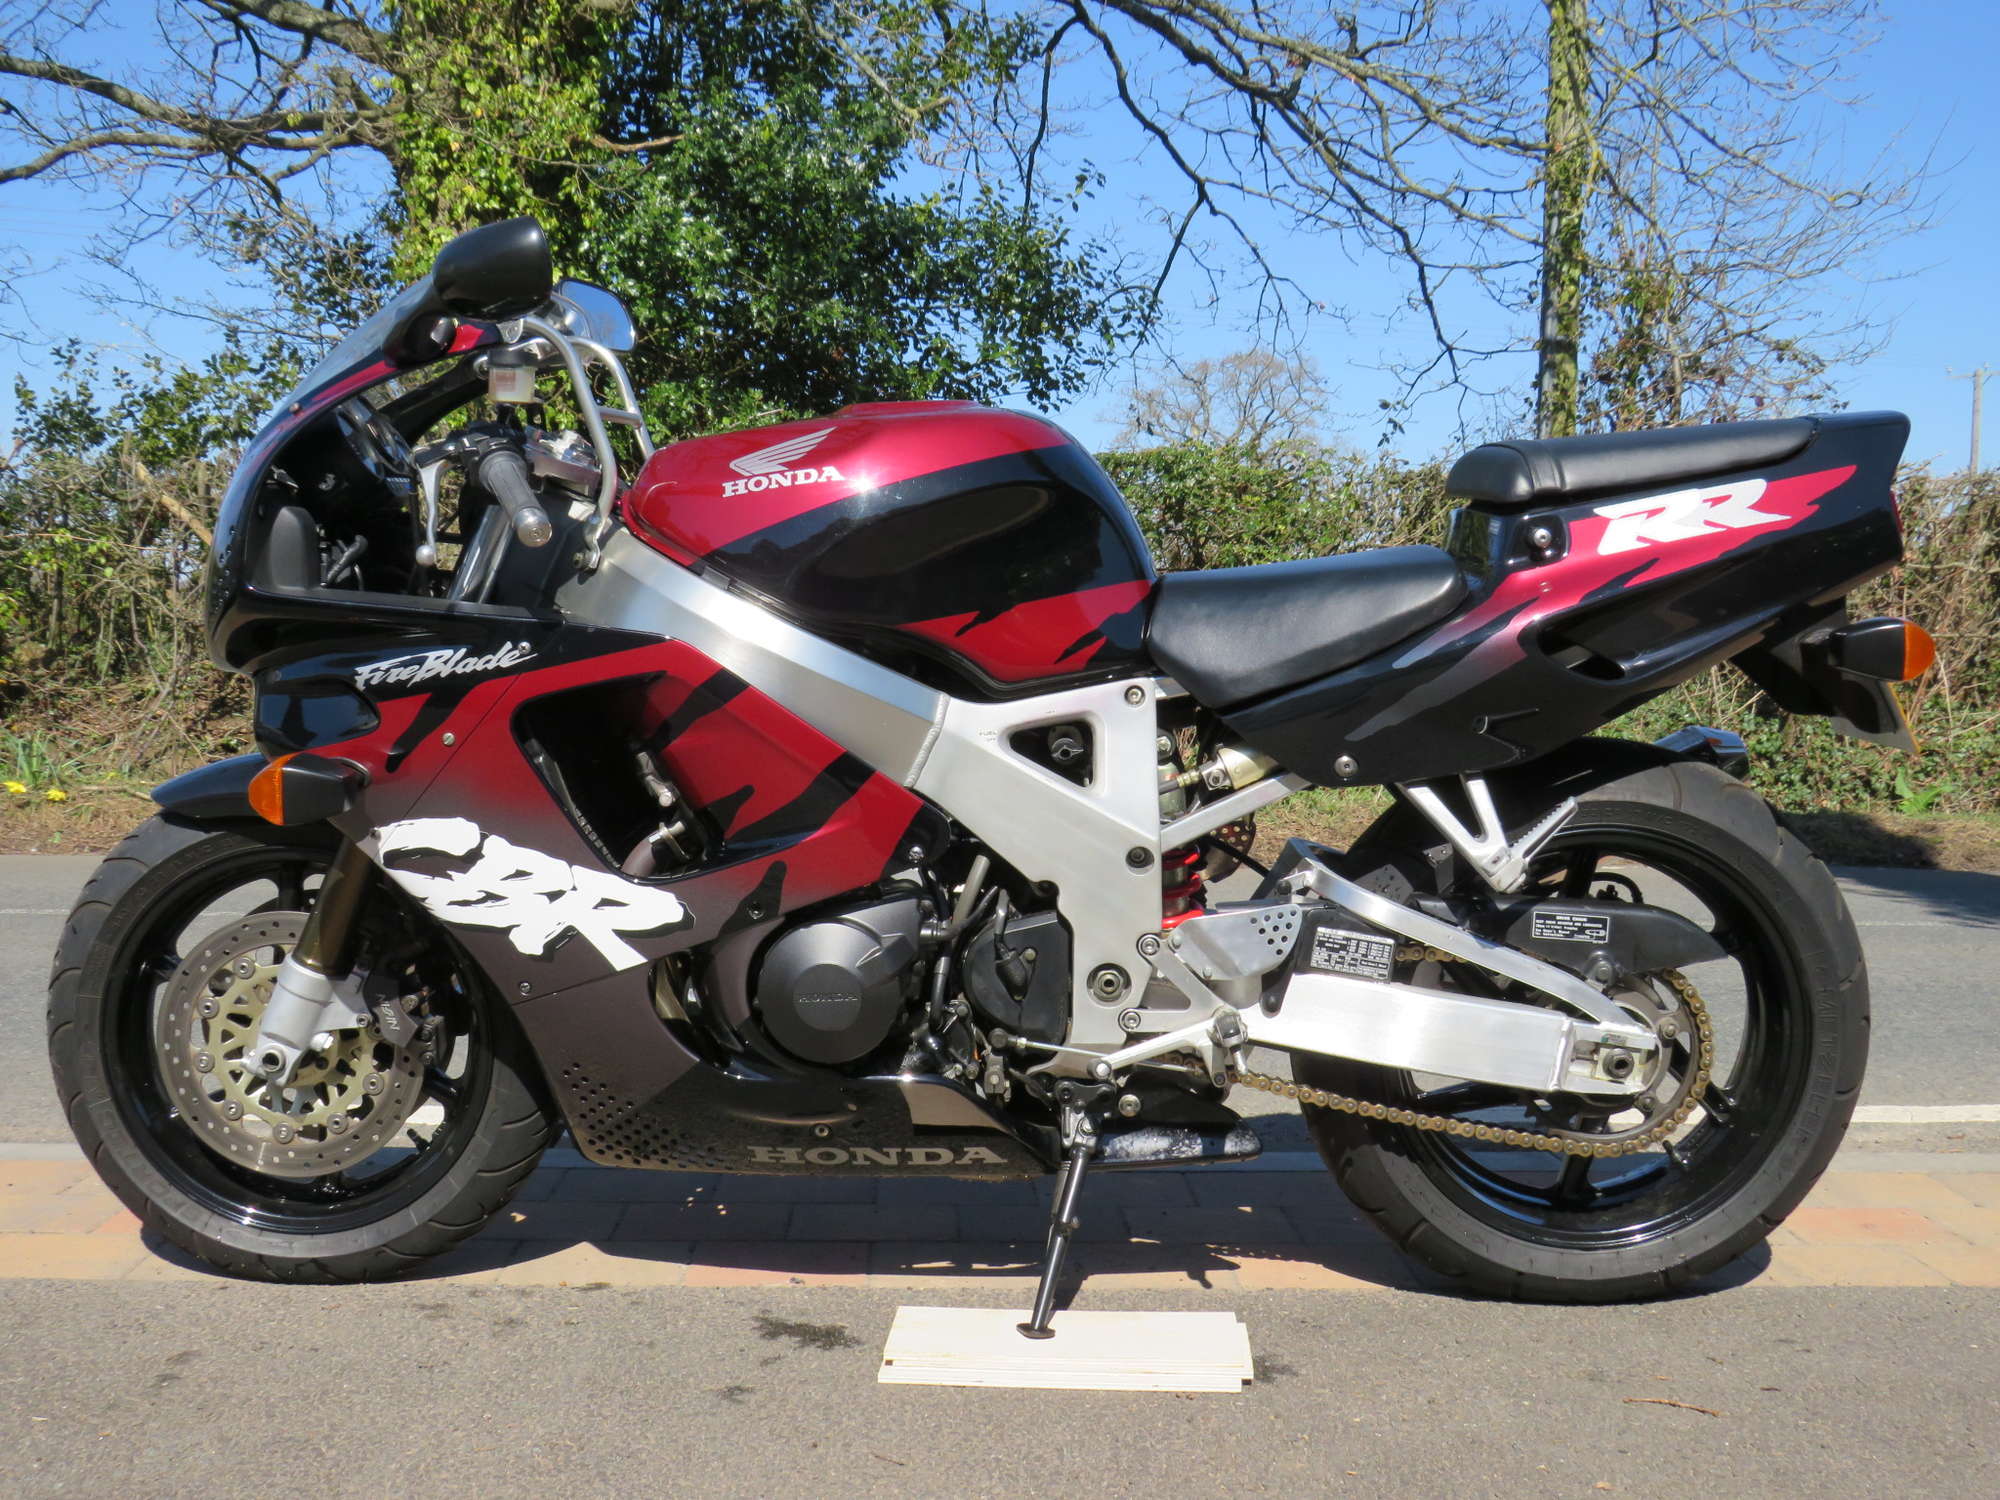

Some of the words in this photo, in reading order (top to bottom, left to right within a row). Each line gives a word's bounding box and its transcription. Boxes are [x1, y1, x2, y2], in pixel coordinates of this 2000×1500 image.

[722, 466, 846, 498] HONDA
[1593, 478, 1792, 556] RR
[354, 641, 539, 692] FireBlade
[378, 816, 687, 972] CBR
[747, 1146, 1008, 1166] HONDA
